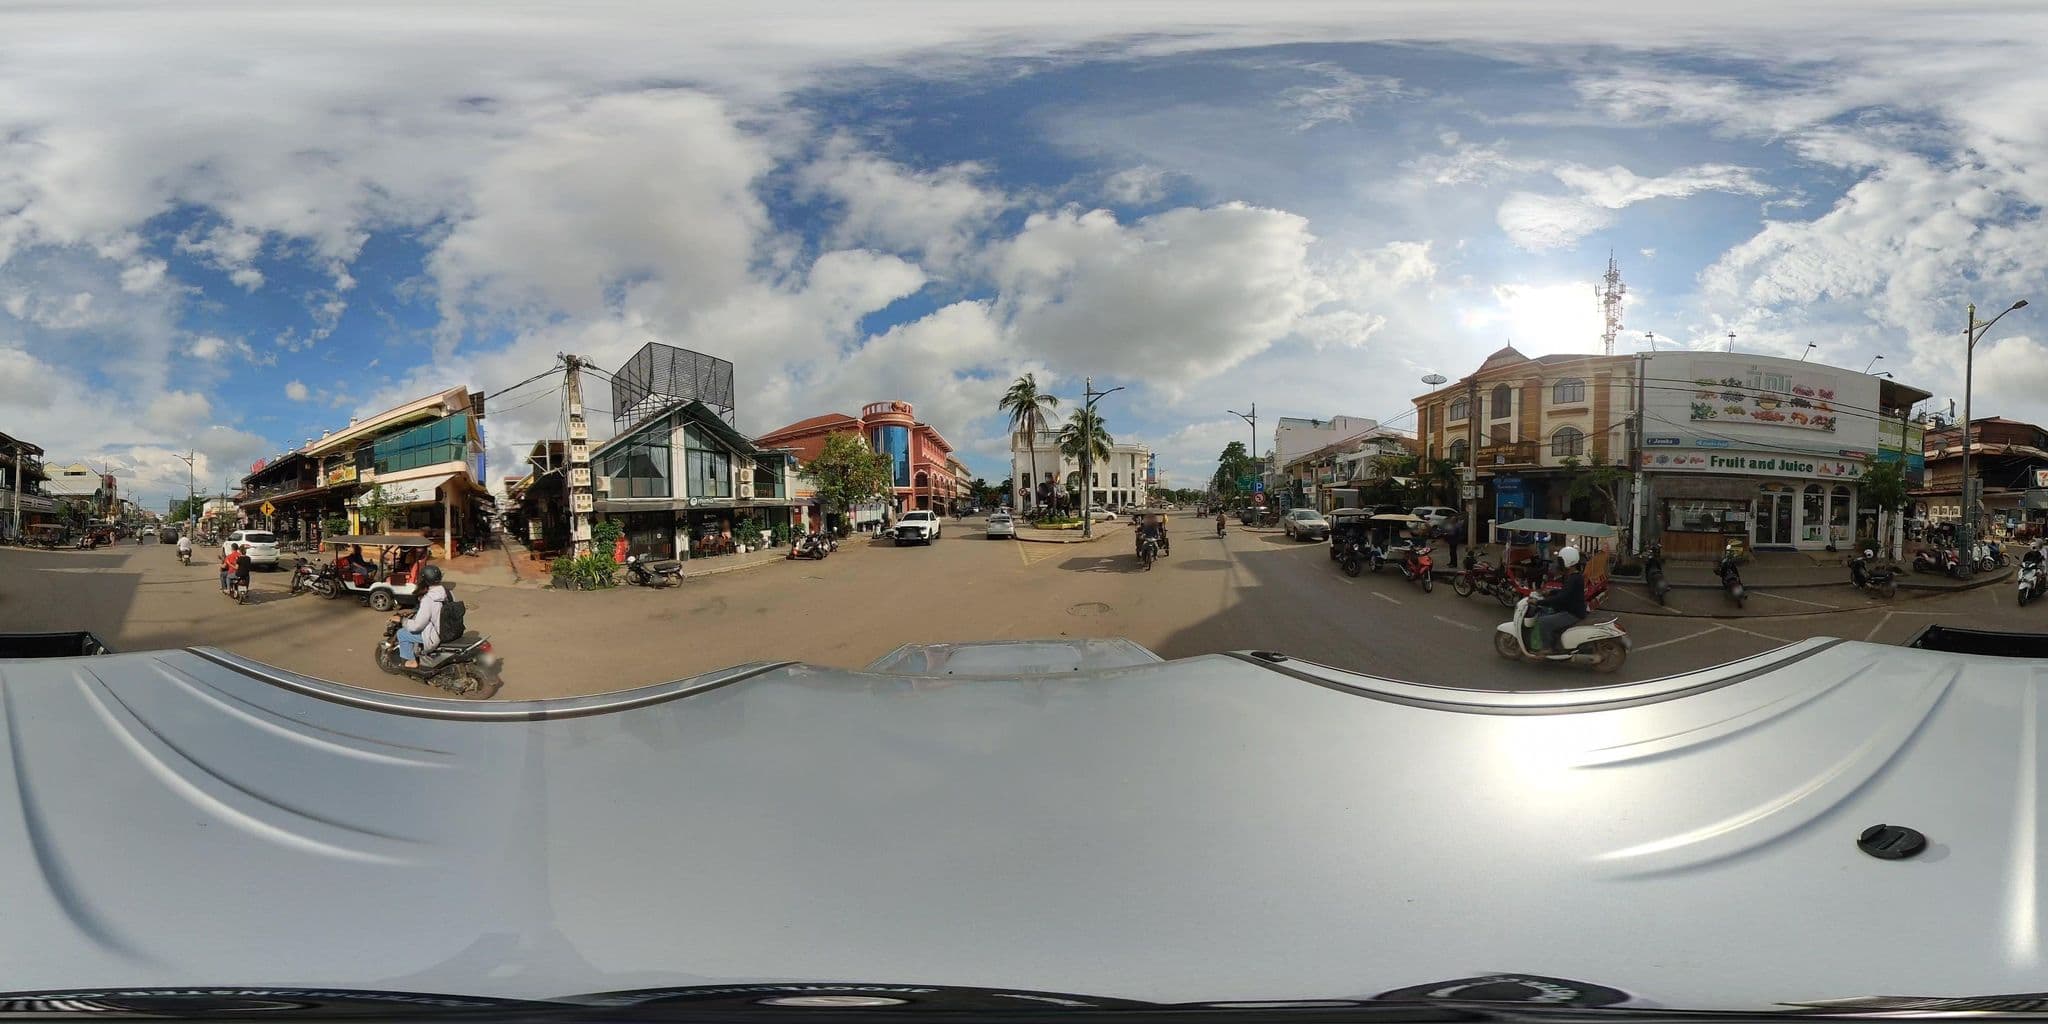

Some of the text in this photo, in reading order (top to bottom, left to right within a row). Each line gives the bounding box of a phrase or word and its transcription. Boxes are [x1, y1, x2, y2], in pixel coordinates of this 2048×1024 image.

[1710, 455, 1814, 473] Fruit and Juice
[1256, 482, 1263, 492] P
